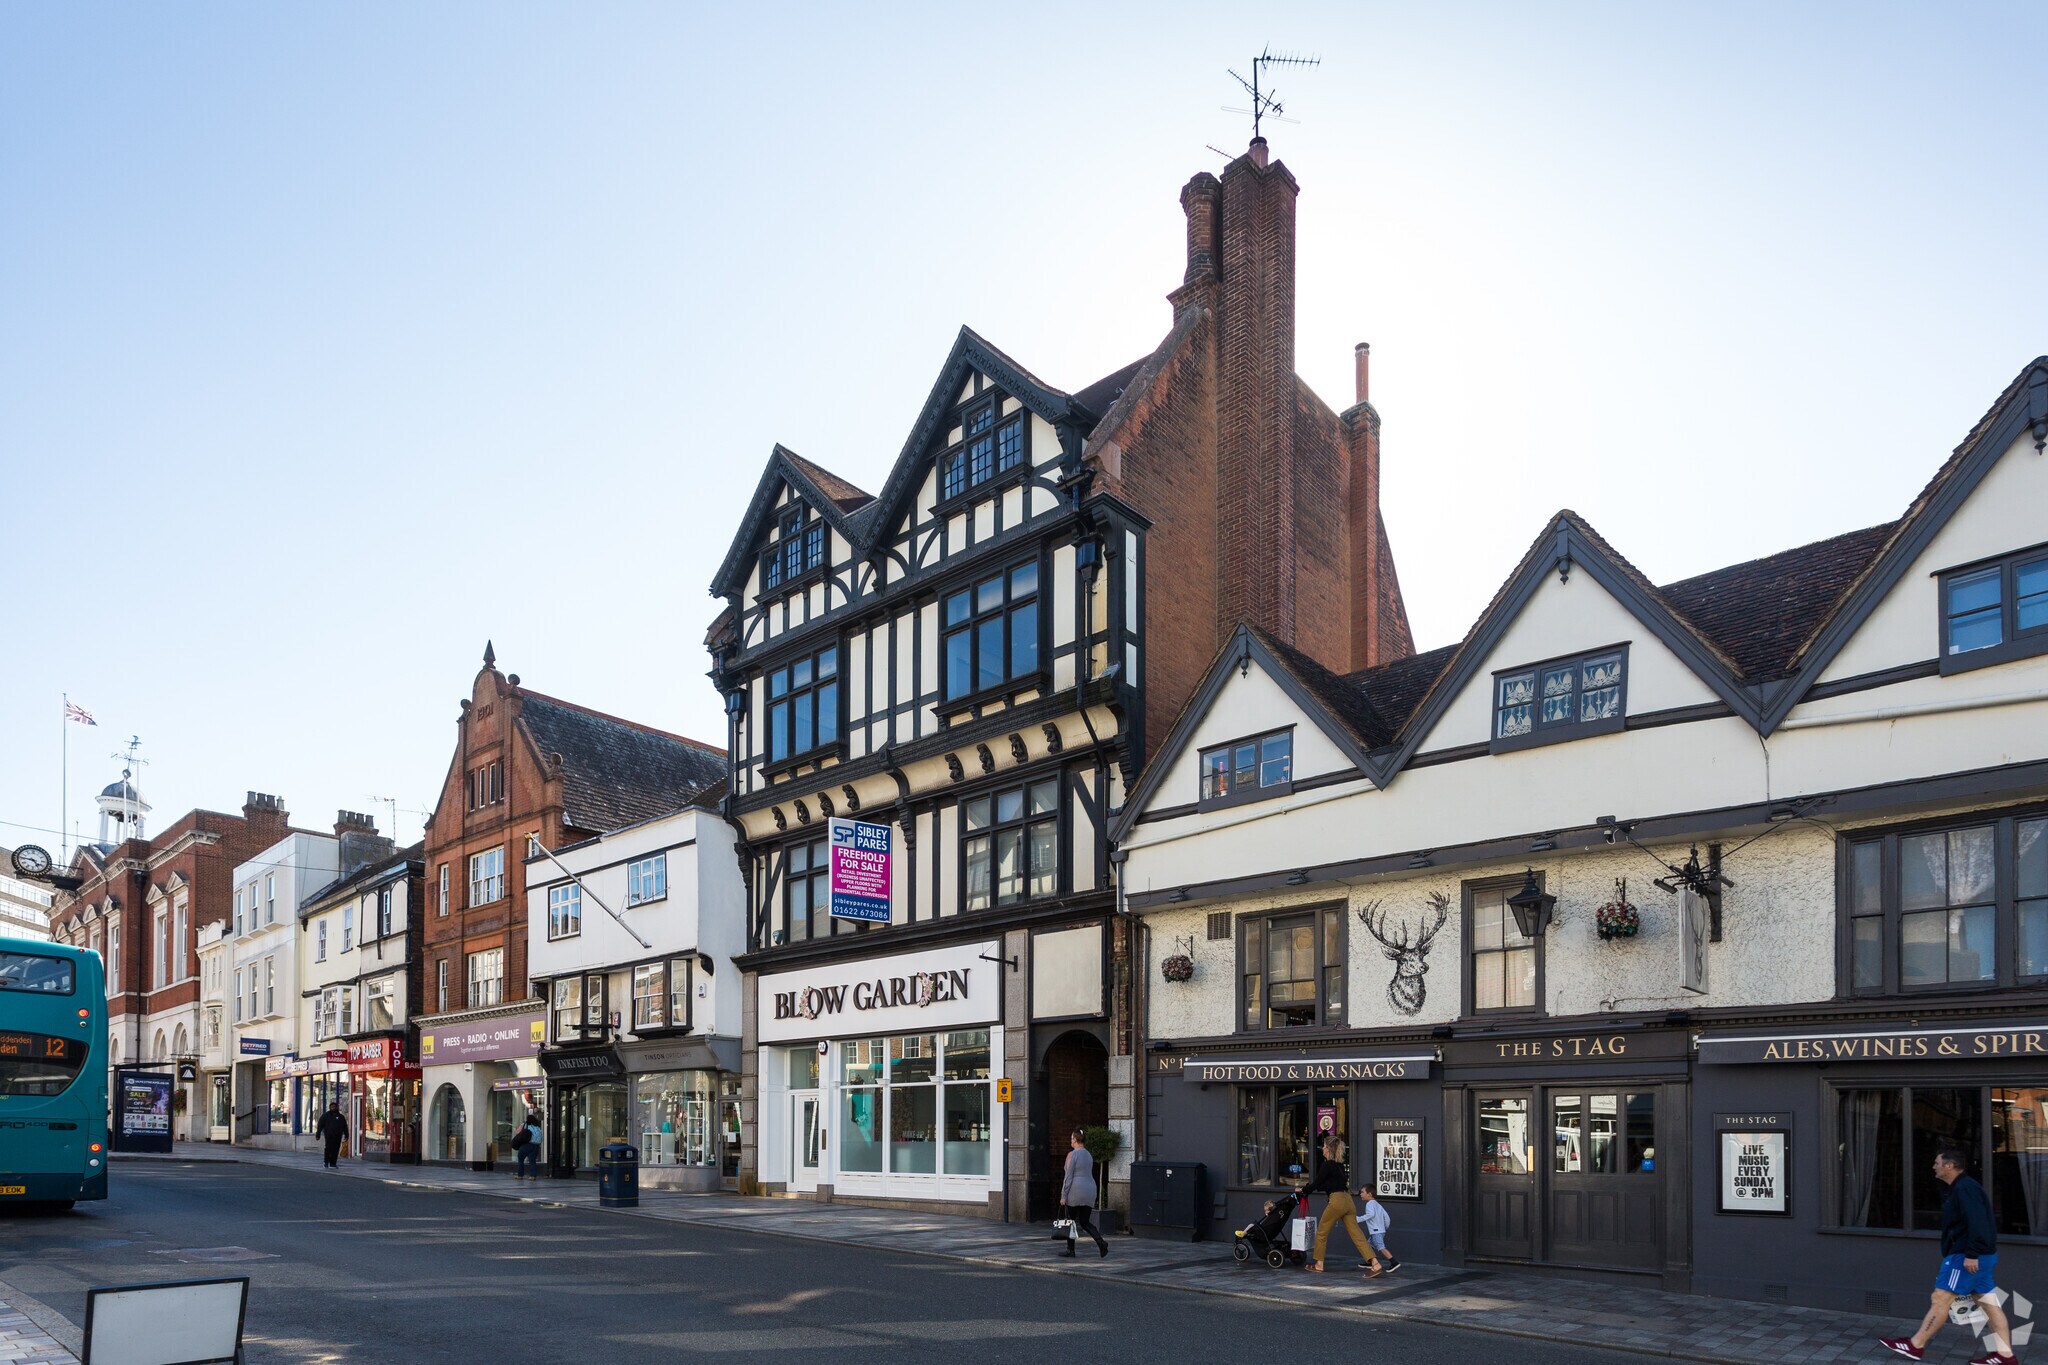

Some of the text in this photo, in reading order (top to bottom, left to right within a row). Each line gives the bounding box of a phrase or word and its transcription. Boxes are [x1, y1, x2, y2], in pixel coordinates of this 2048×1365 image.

[857, 826, 887, 840] SIBLEY
[857, 837, 887, 850] PARES
[838, 848, 885, 862] FREEHOLD
[840, 858, 883, 872] FOR SALE
[836, 873, 886, 885] (BUSINESS UNAFFECTED)
[856, 871, 882, 879] INVESTMENT
[846, 884, 868, 892] PLANNING
[862, 891, 888, 899] CONVERSION
[834, 898, 887, 909] sibleypares.co.uk
[833, 906, 888, 919] 01622 673086
[774, 968, 971, 1020] BLOW GARDEN
[443, 1028, 520, 1047] PRESS RADIO ONLINE
[531, 1032, 541, 1040] KM
[45, 1038, 65, 1057] 12
[423, 1045, 432, 1053] KM
[1496, 1036, 1626, 1057] THE STAG
[1937, 1036, 1962, 1055] &
[1974, 1033, 2048, 1054] SPIR
[350, 1042, 382, 1060] TOP BARBER
[393, 1040, 402, 1068] TOP
[644, 1051, 692, 1061] TINSON OPTICIANS
[557, 1055, 609, 1070] INKFISH TOO
[1202, 1062, 1405, 1080] HOT FOOD & BAR SNACKS
[1748, 1116, 1776, 1124] STAG
[1382, 1159, 1413, 1171] EVERY
[1738, 1155, 1770, 1166] MUSIC
[1379, 1171, 1417, 1183] SUNDAY
[1737, 1166, 1770, 1177] EVERY
[1734, 1176, 1775, 1188] SUNDAY
[1380, 1183, 1416, 1195] @ 3PM
[1735, 1187, 1774, 1198] @ 3PM
